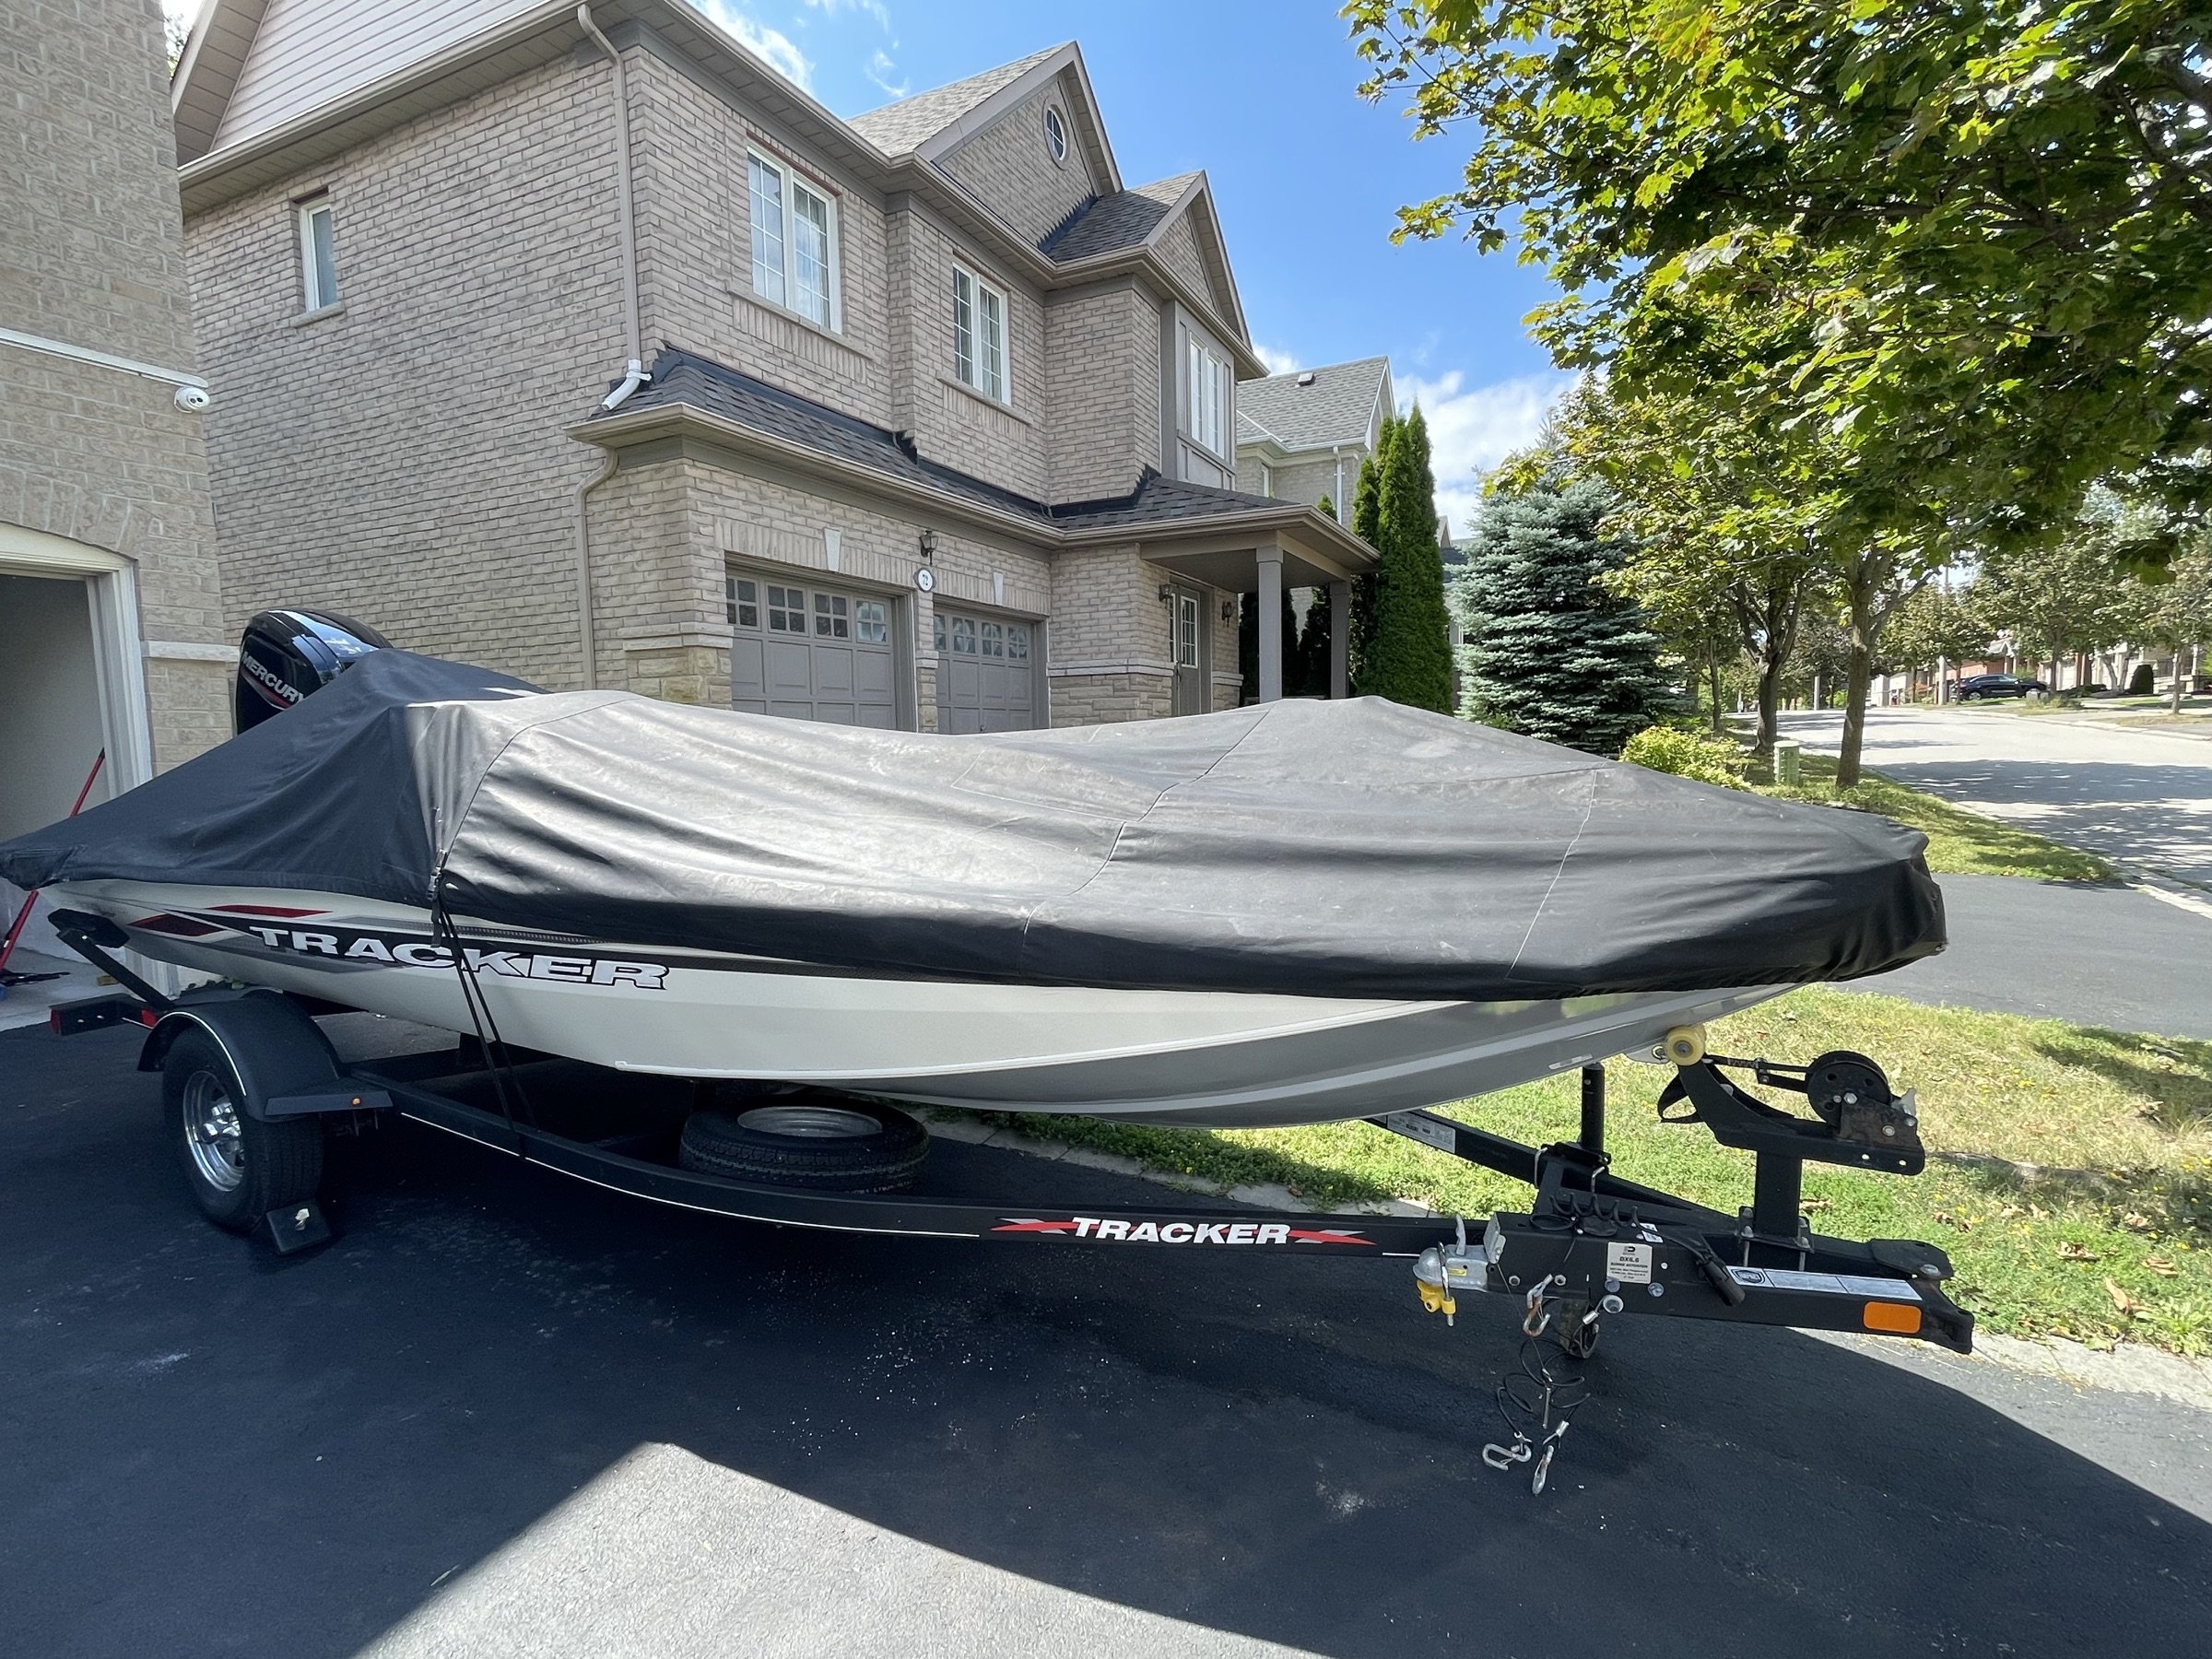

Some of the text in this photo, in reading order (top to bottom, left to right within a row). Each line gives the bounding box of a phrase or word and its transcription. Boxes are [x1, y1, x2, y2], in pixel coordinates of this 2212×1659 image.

[922, 573, 929, 586] 72
[249, 925, 668, 989] TRACKER
[1071, 1217, 1291, 1244] TRACKER
